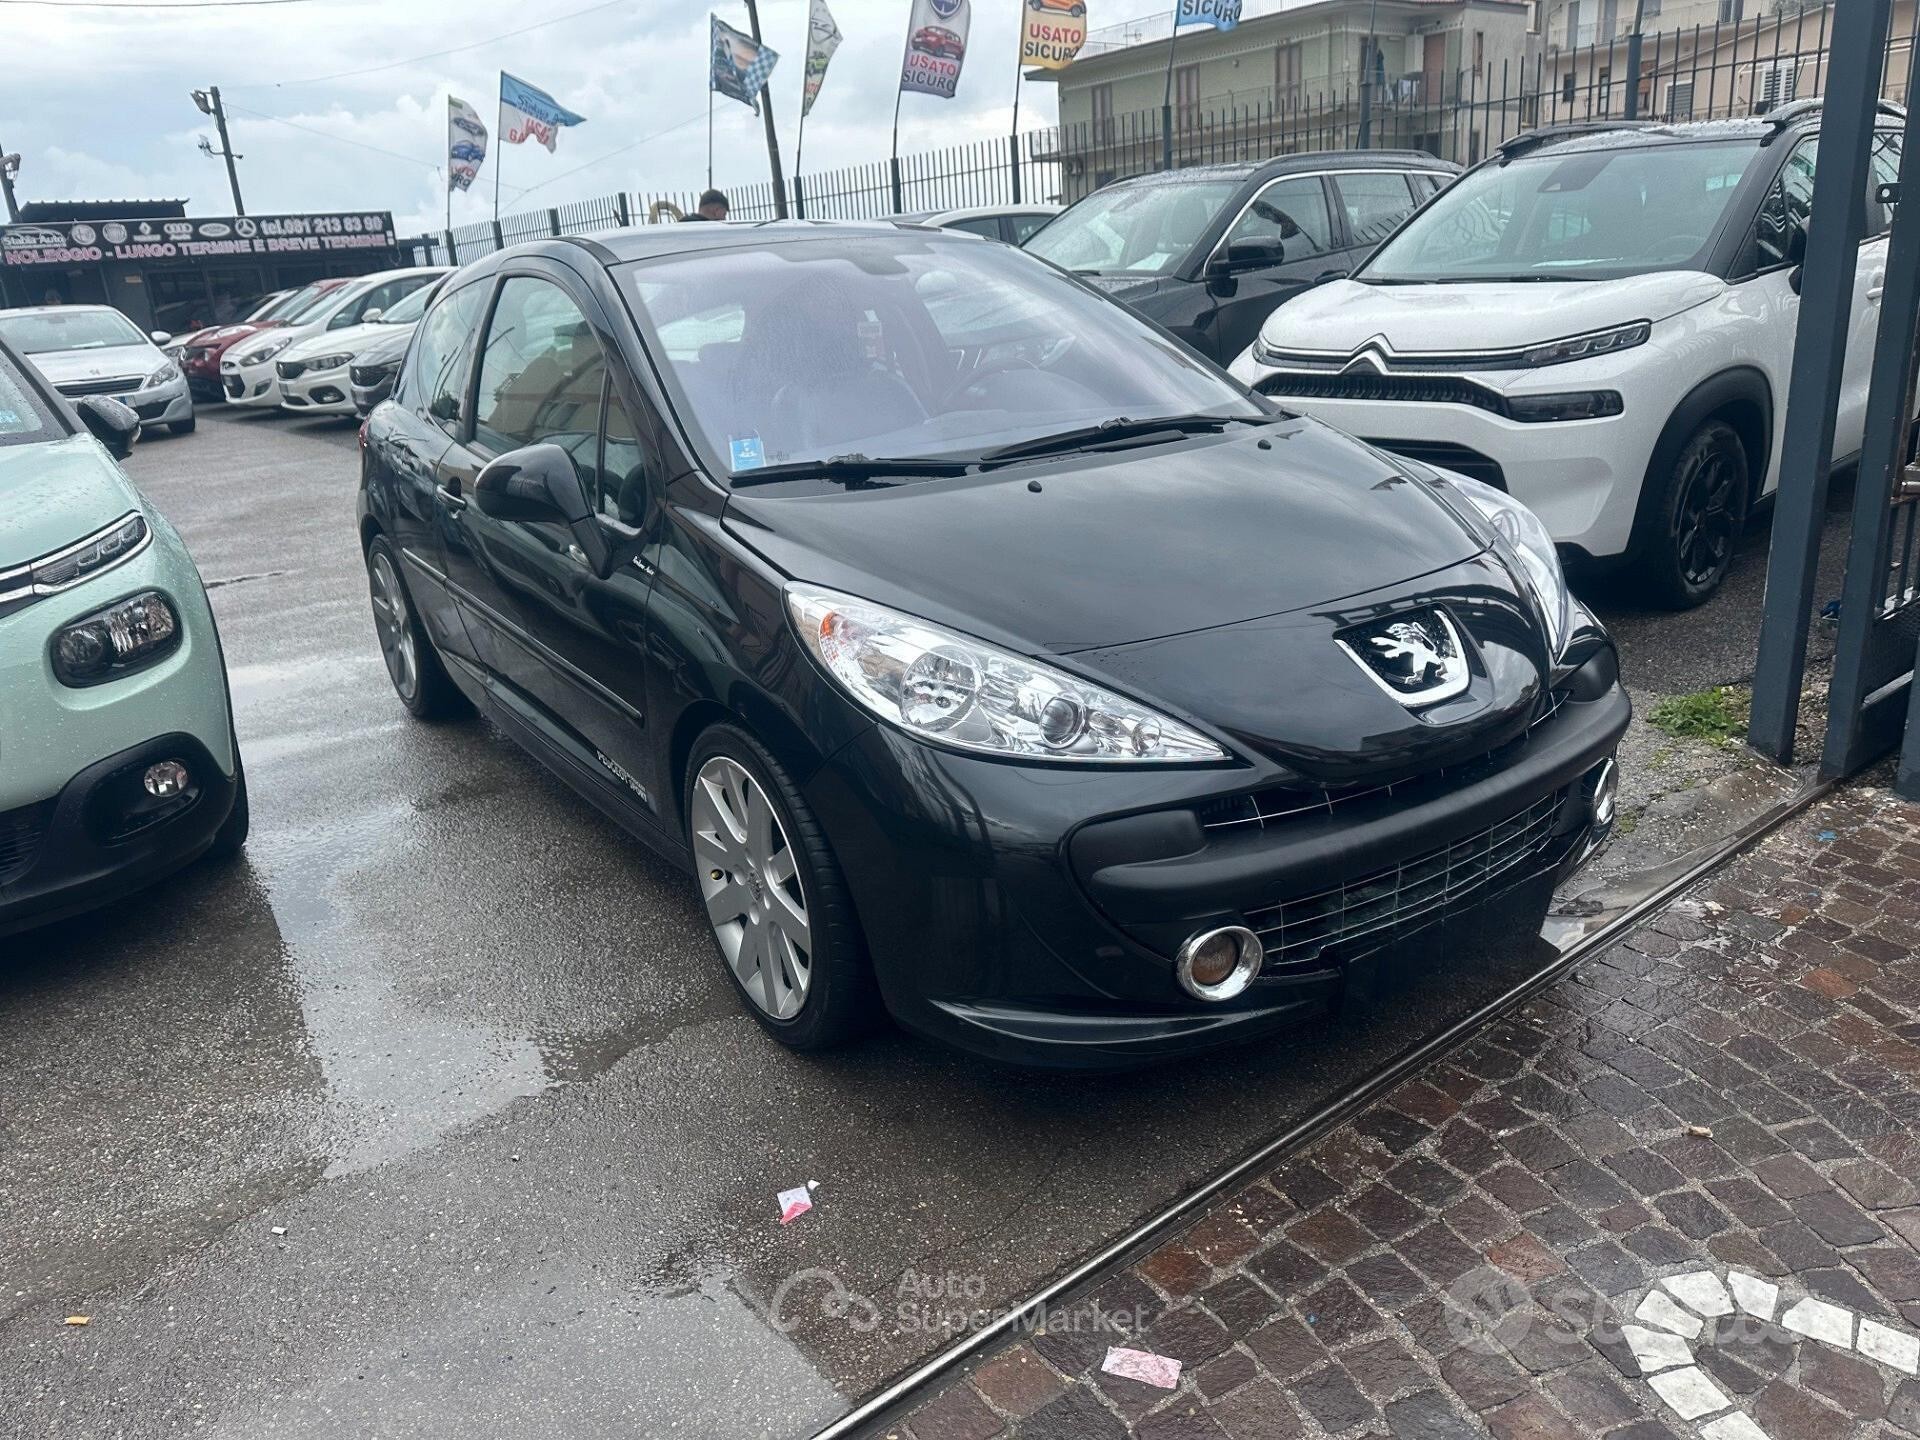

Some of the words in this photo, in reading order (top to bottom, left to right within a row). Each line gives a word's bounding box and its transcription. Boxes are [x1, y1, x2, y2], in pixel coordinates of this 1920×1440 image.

[1182, 0, 1242, 22] SICURO
[1030, 23, 1081, 43] USATO
[910, 54, 956, 76] USATO
[902, 69, 955, 92] SICURO
[314, 217, 342, 234] 213
[5, 247, 102, 265] NOLEGGIO
[115, 243, 176, 259] LUNGO
[177, 239, 251, 255] TERMINE
[253, 238, 266, 252] E
[267, 236, 320, 252] BREVE
[320, 233, 387, 249] TERMINE
